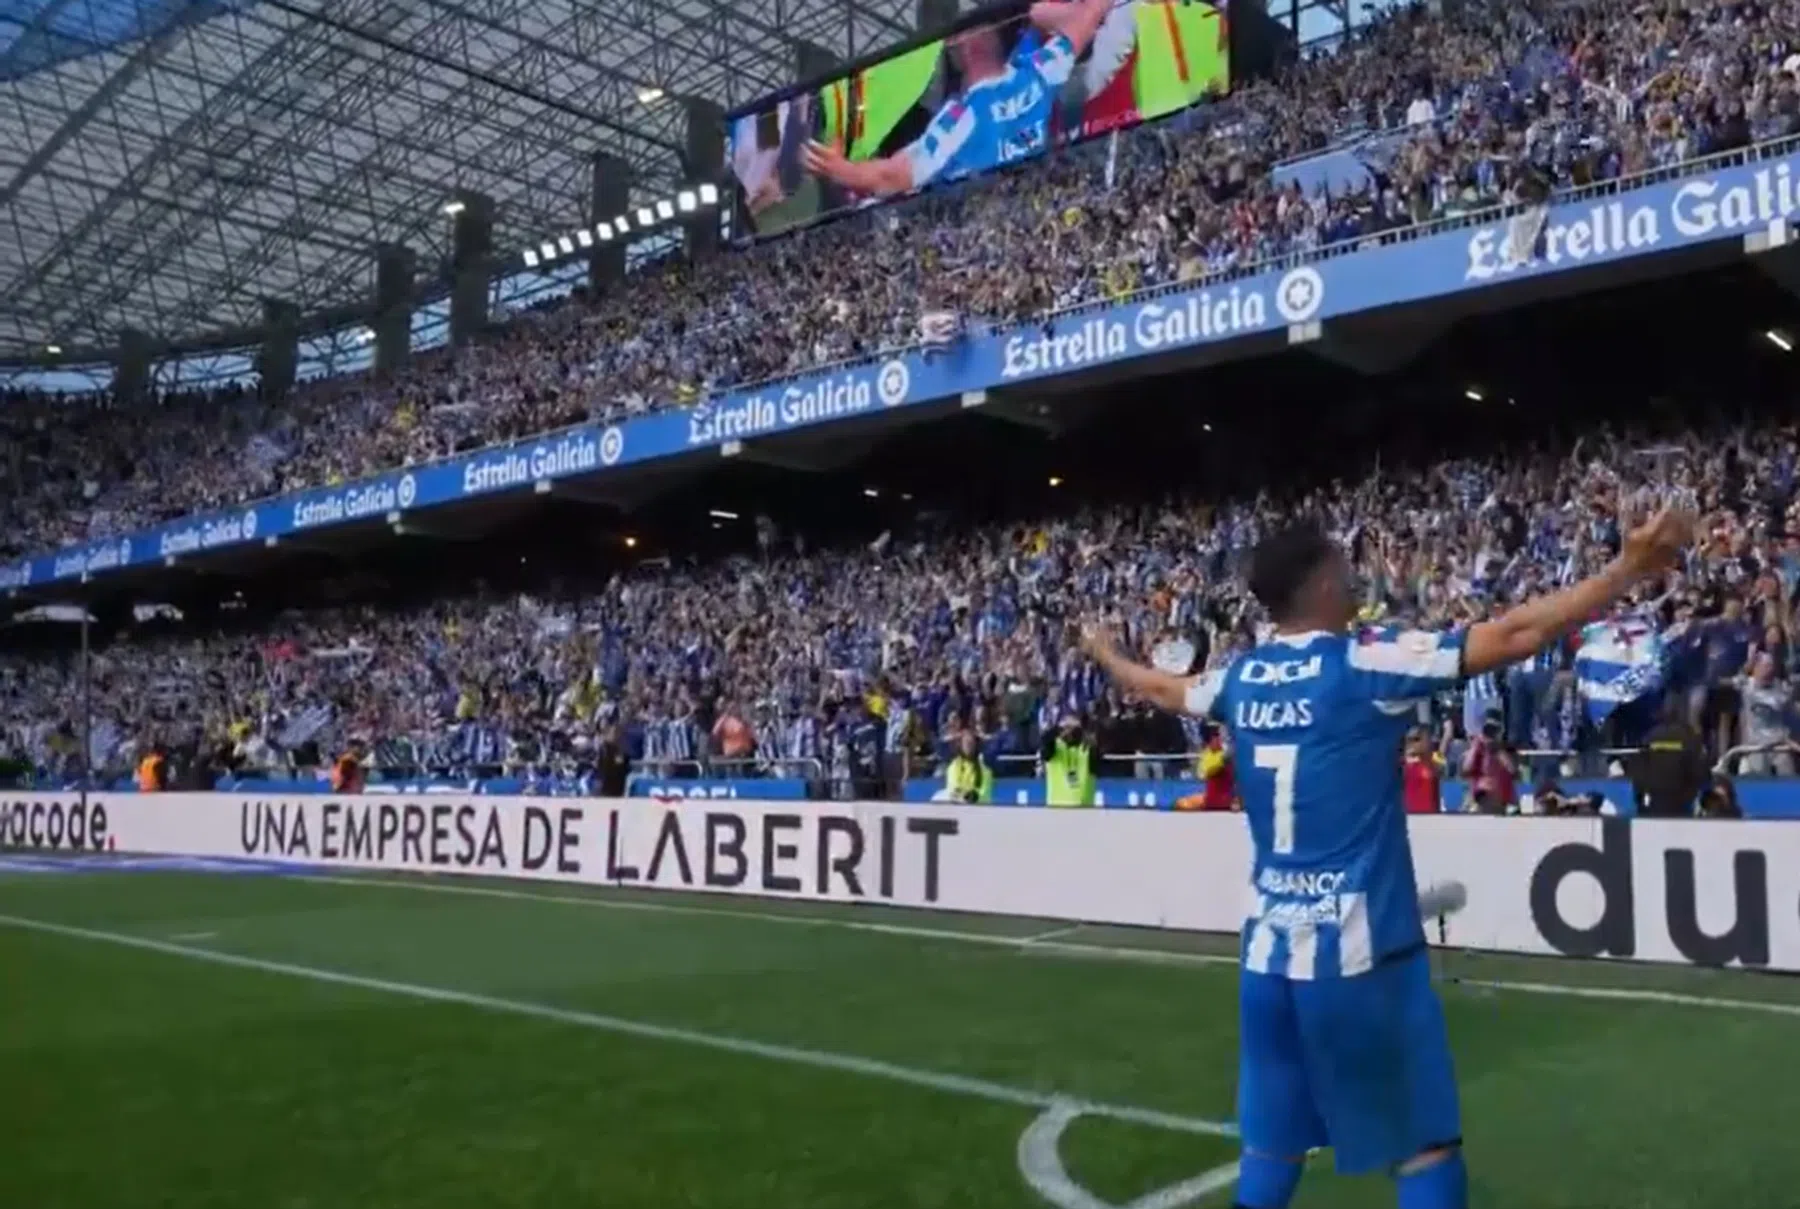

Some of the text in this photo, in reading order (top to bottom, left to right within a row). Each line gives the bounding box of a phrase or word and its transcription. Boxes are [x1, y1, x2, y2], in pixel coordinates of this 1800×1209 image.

[1672, 161, 1800, 236] Gali
[1001, 286, 1266, 377] Estrella Galicia
[688, 374, 870, 444] Estrella Galicia
[463, 436, 596, 493] Estrella Galicia
[1236, 699, 1314, 729] LUCAS
[1253, 743, 1300, 854] 7
[240, 801, 310, 856] UNA
[321, 804, 507, 868] EMPRESA
[522, 806, 582, 873] DE
[607, 808, 960, 902] LABERIT
[1529, 816, 1800, 966] du
